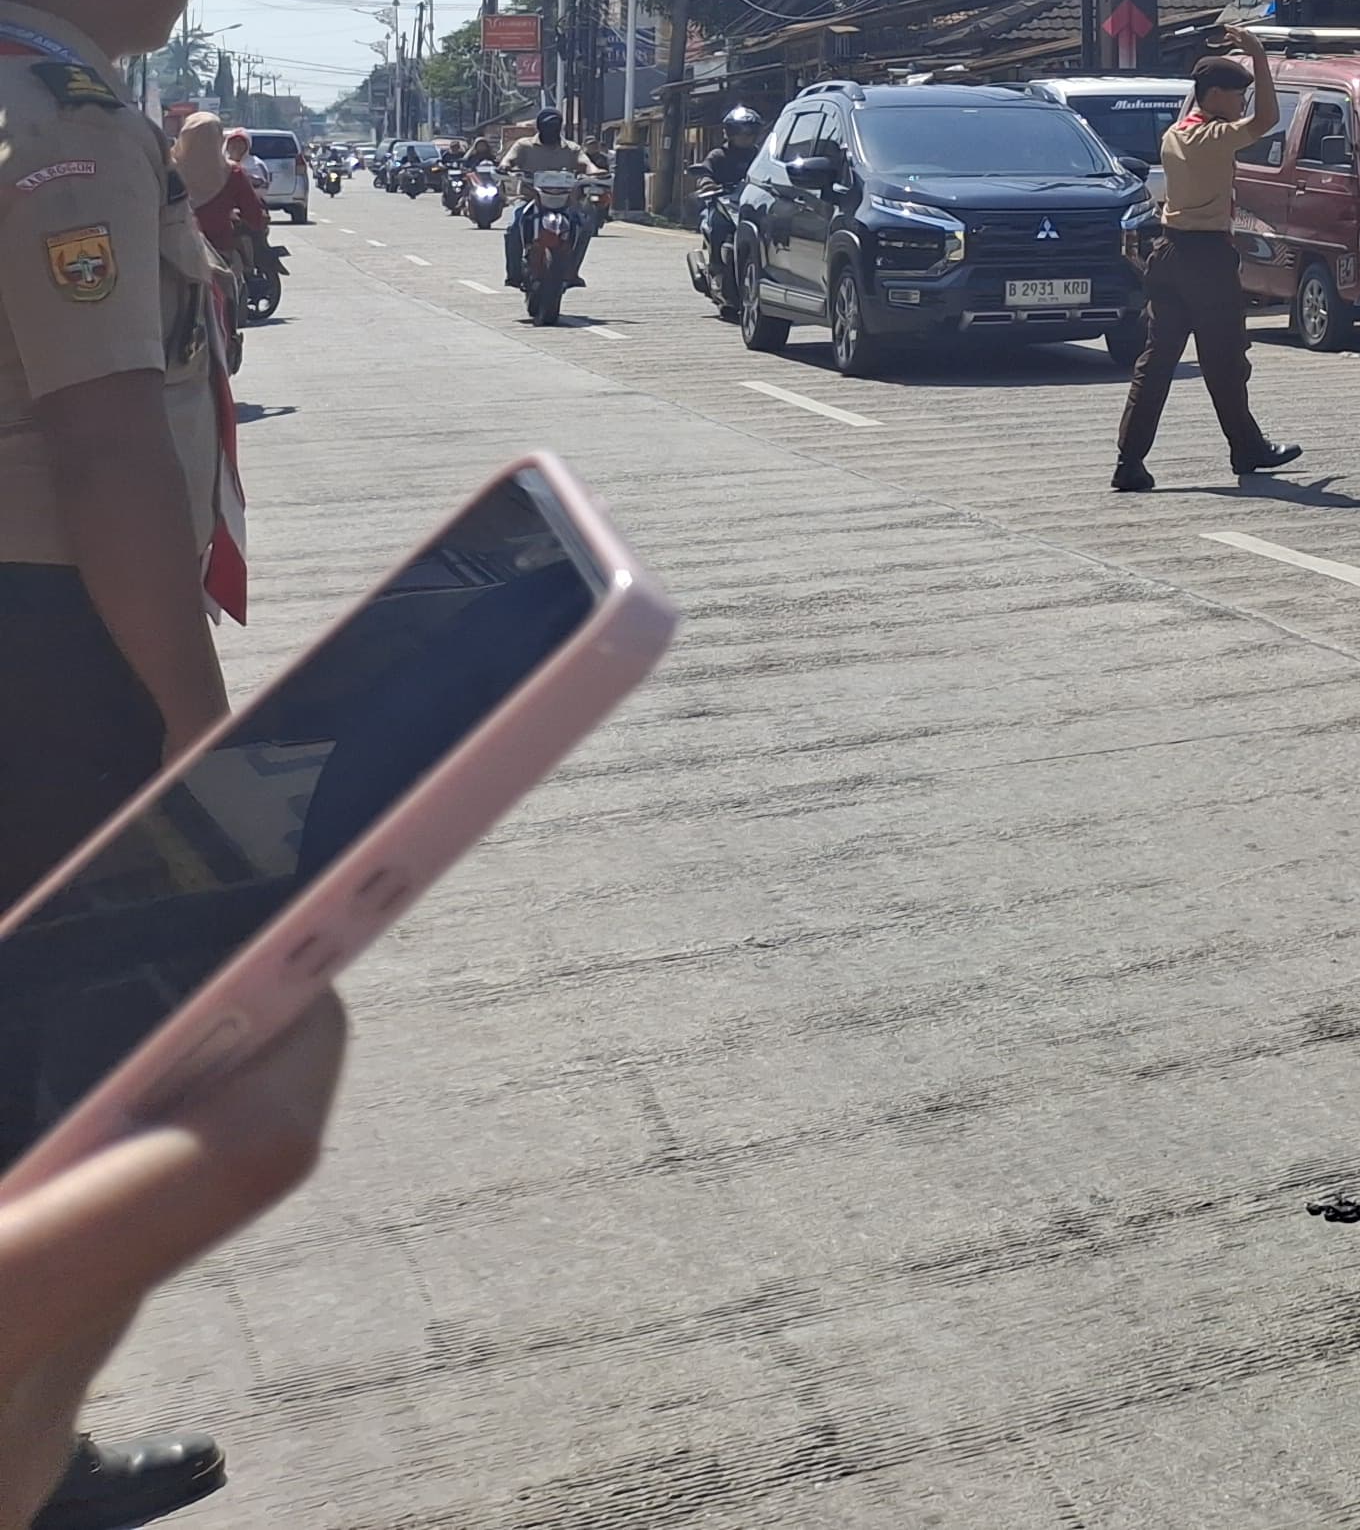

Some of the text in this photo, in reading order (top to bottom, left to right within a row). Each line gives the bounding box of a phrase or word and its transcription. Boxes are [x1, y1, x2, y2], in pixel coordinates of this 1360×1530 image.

[1009, 281, 1089, 297] B 2931 KRD
